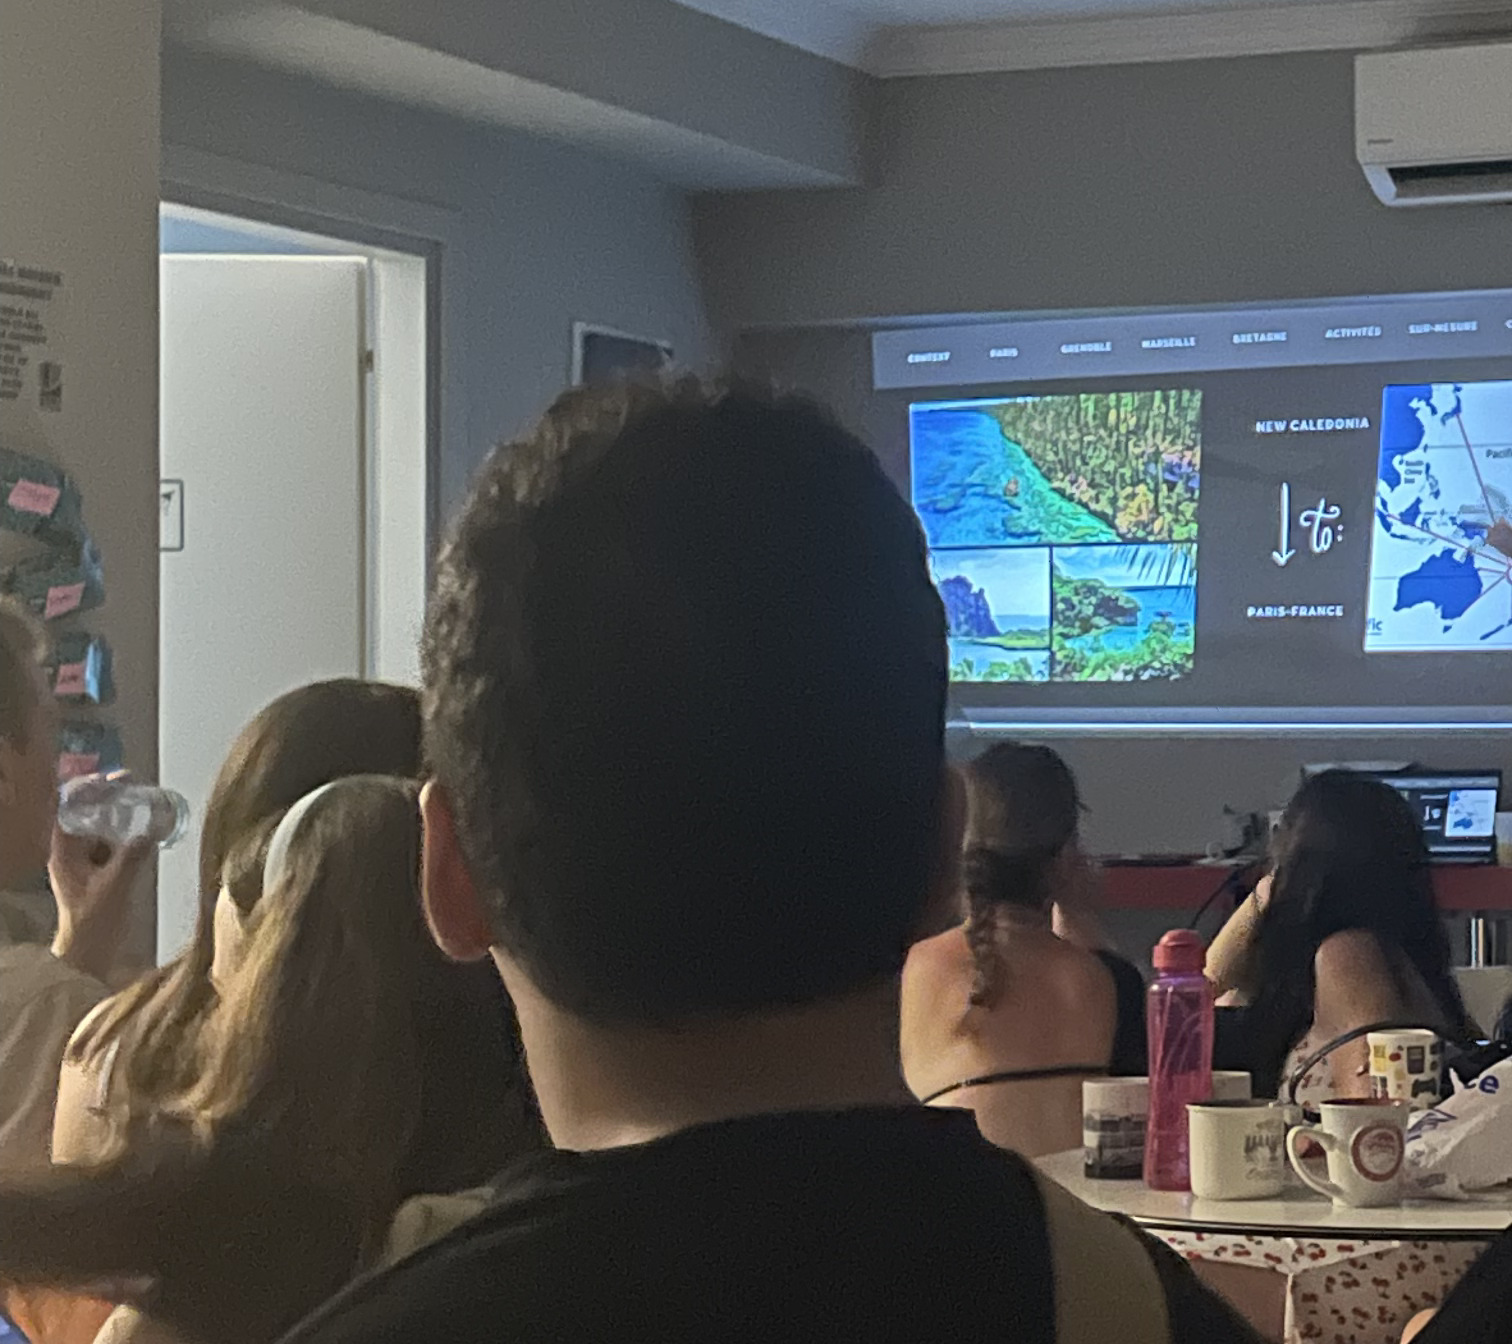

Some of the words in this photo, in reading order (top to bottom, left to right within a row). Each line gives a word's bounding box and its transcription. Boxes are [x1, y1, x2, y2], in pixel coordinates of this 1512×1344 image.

[990, 348, 1018, 358] PARIS
[1060, 342, 1112, 353] GRENOBLE
[1141, 337, 1196, 348] MARSEILLE
[1232, 331, 1287, 344] BRETAGNE
[1255, 420, 1286, 433] NEW
[1289, 417, 1370, 432] CALEDONIA
[1299, 497, 1344, 553] to:
[1247, 606, 1344, 617] PARIS-FRANCE
